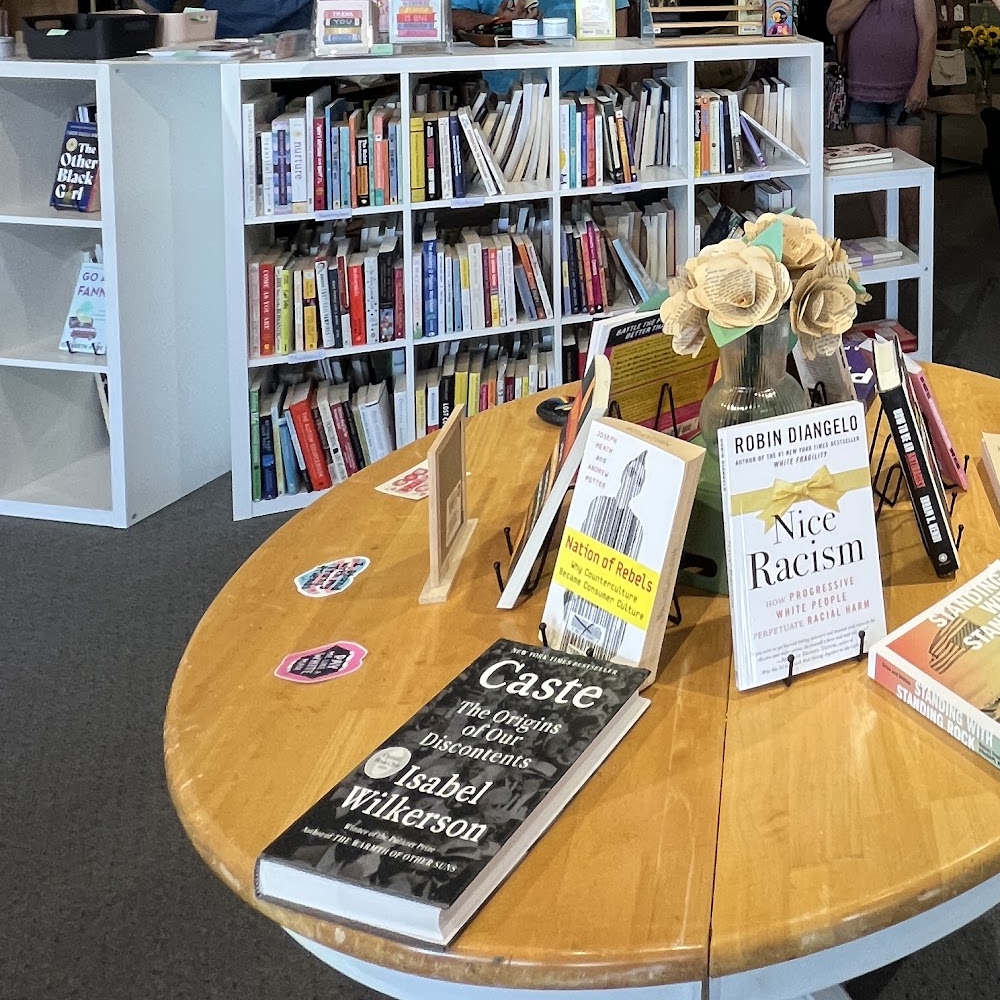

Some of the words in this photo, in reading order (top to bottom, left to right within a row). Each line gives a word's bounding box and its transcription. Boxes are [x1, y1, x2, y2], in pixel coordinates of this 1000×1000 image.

[60, 152, 99, 170] Other
[78, 142, 96, 155] The
[294, 141, 303, 180] nurture
[56, 167, 93, 186] Black
[82, 272, 98, 282] GO
[734, 429, 782, 454] ROBIN
[788, 415, 859, 444] DIANGELO
[766, 452, 776, 460] THE
[786, 448, 798, 456] NEW
[798, 445, 813, 454] YORK
[813, 442, 829, 452] TIMES
[588, 463, 610, 478] ANDREW
[773, 456, 794, 468] WHITE
[796, 451, 828, 464] FRAGILITY
[584, 475, 606, 490] POTTER
[771, 510, 838, 545] Nice
[565, 535, 600, 566] Nation
[601, 556, 616, 572] of
[615, 561, 654, 593] Rebels
[746, 539, 866, 591] Racism
[558, 567, 582, 586] Became
[583, 581, 616, 603] Consumer
[616, 600, 645, 620] Culture
[584, 568, 638, 603] Counterculture
[766, 596, 786, 608] HOW
[789, 576, 855, 602] PROGRESSIVE
[753, 620, 804, 640] PERPETUATE
[807, 608, 842, 625] RACIAL
[845, 600, 870, 614] HARM
[775, 603, 806, 619] WHITE
[811, 592, 848, 610] PEOPLE
[550, 656, 572, 666] TIMES
[480, 660, 603, 708] Caste
[457, 700, 491, 720] The
[492, 709, 562, 735] Origins
[896, 684, 945, 730] STANDING
[946, 719, 976, 751] ROCK
[914, 680, 965, 722] STANDING
[966, 714, 994, 748] WITH
[419, 732, 532, 769] Discontents
[461, 724, 491, 738] of
[485, 727, 524, 746] Our
[394, 764, 494, 805] Isabel
[340, 785, 488, 843] Wilkerson
[333, 834, 350, 846] THE
[351, 838, 390, 856] WARMTH
[388, 850, 403, 860] OF
[402, 852, 434, 868] OTHER
[434, 861, 458, 873] SUNS
